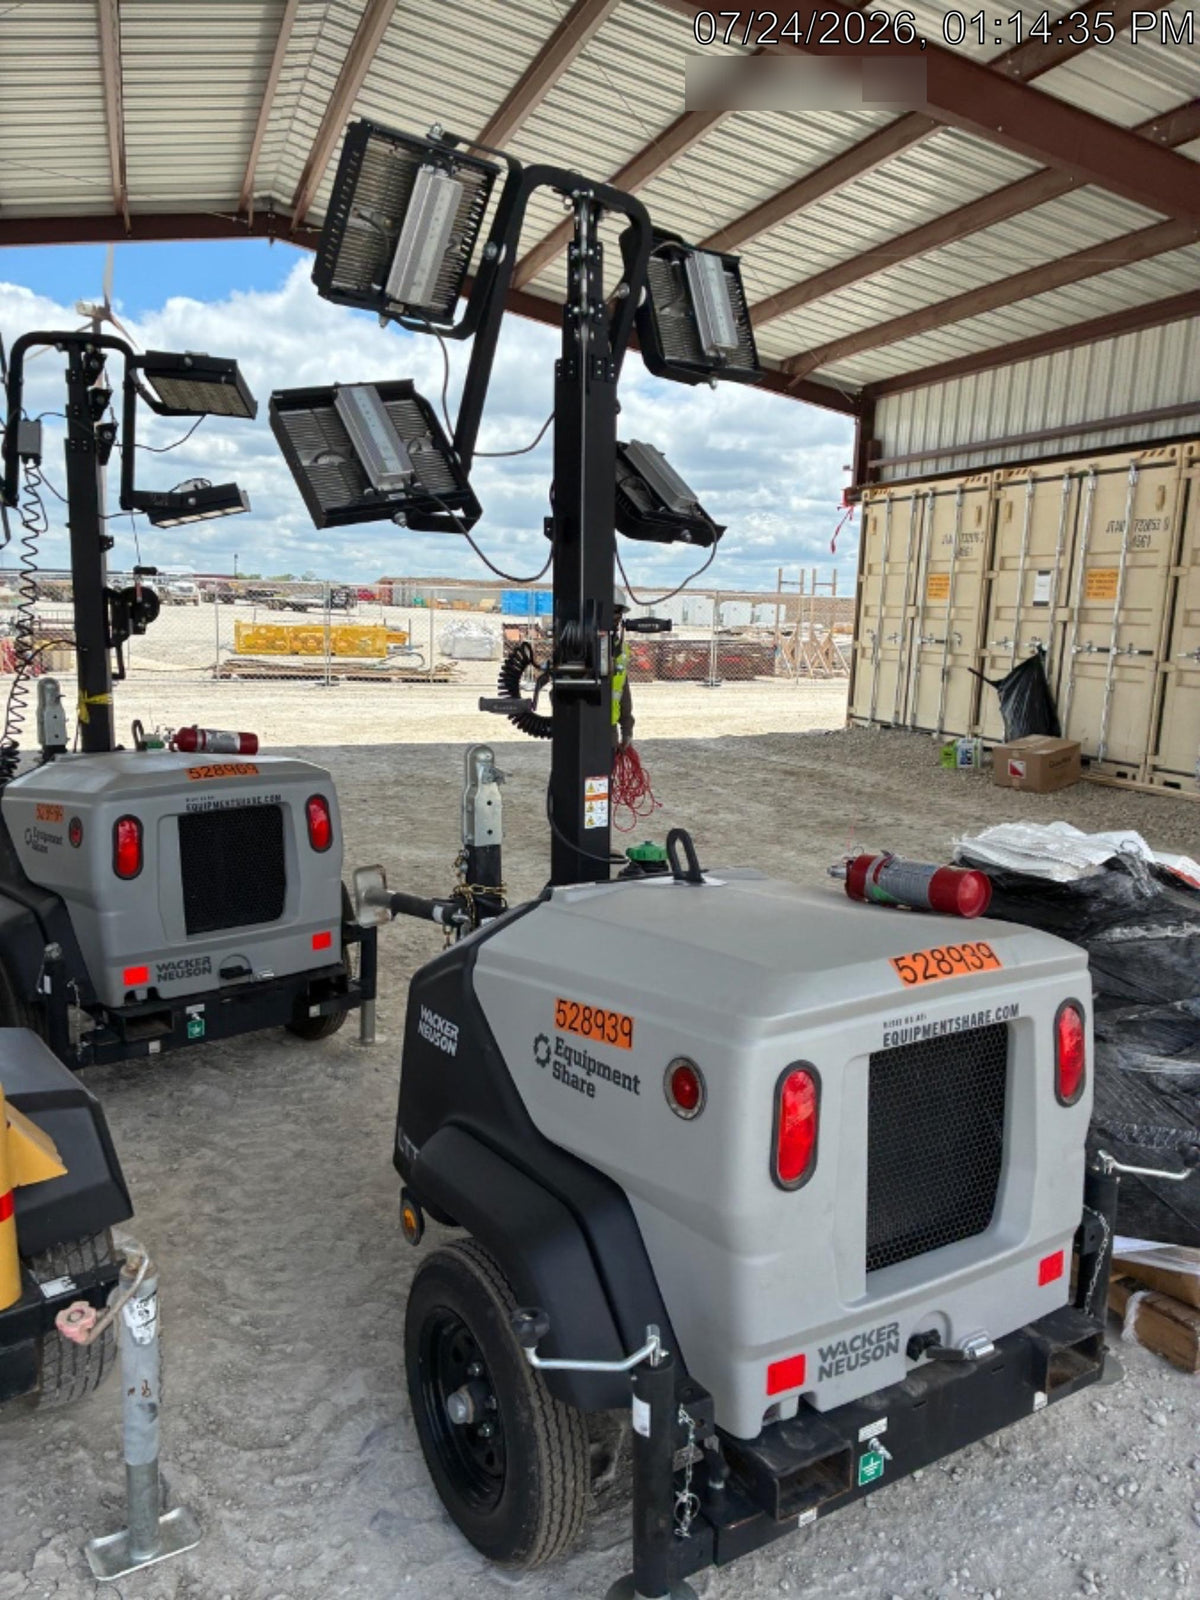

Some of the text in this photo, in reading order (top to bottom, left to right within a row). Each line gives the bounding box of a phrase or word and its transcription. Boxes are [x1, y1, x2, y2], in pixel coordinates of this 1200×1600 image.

[156, 956, 212, 972] WACKER
[157, 967, 212, 983] NEUSON
[893, 942, 1000, 984] 528939
[417, 1019, 458, 1057] NEUSON
[420, 1004, 459, 1041] WACKER
[555, 998, 633, 1048] 528939
[882, 1003, 1020, 1047] EQUIPMENTSHARE.COM
[552, 1060, 596, 1098] Share
[554, 1036, 641, 1095] Equipment
[817, 1321, 900, 1362] WACKER
[817, 1339, 900, 1382] NEUSON
